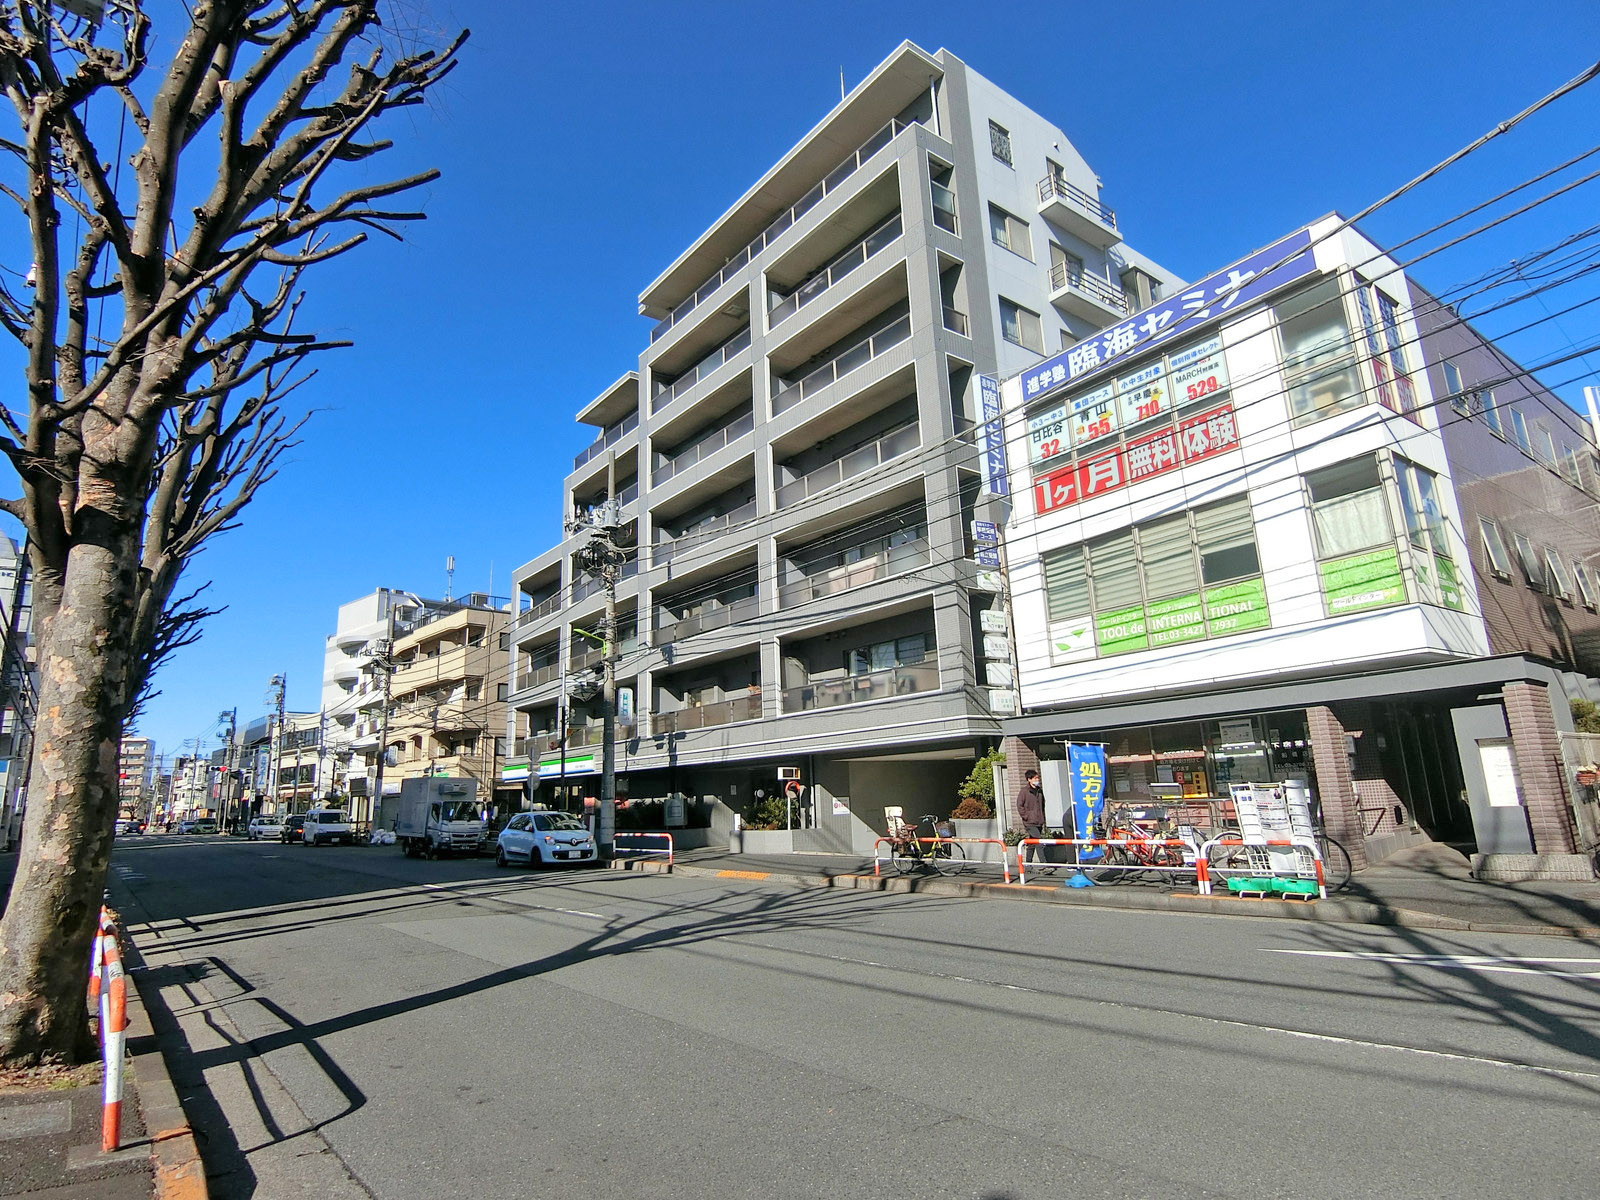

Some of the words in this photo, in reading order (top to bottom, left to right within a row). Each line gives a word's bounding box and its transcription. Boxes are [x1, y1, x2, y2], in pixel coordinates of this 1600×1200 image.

[1026, 363, 1066, 395] 進学塾
[1067, 252, 1306, 377] 臨海セミナー
[1032, 421, 1063, 444] 日比谷
[1102, 625, 1129, 640] TOOL
[1130, 622, 1144, 634] de
